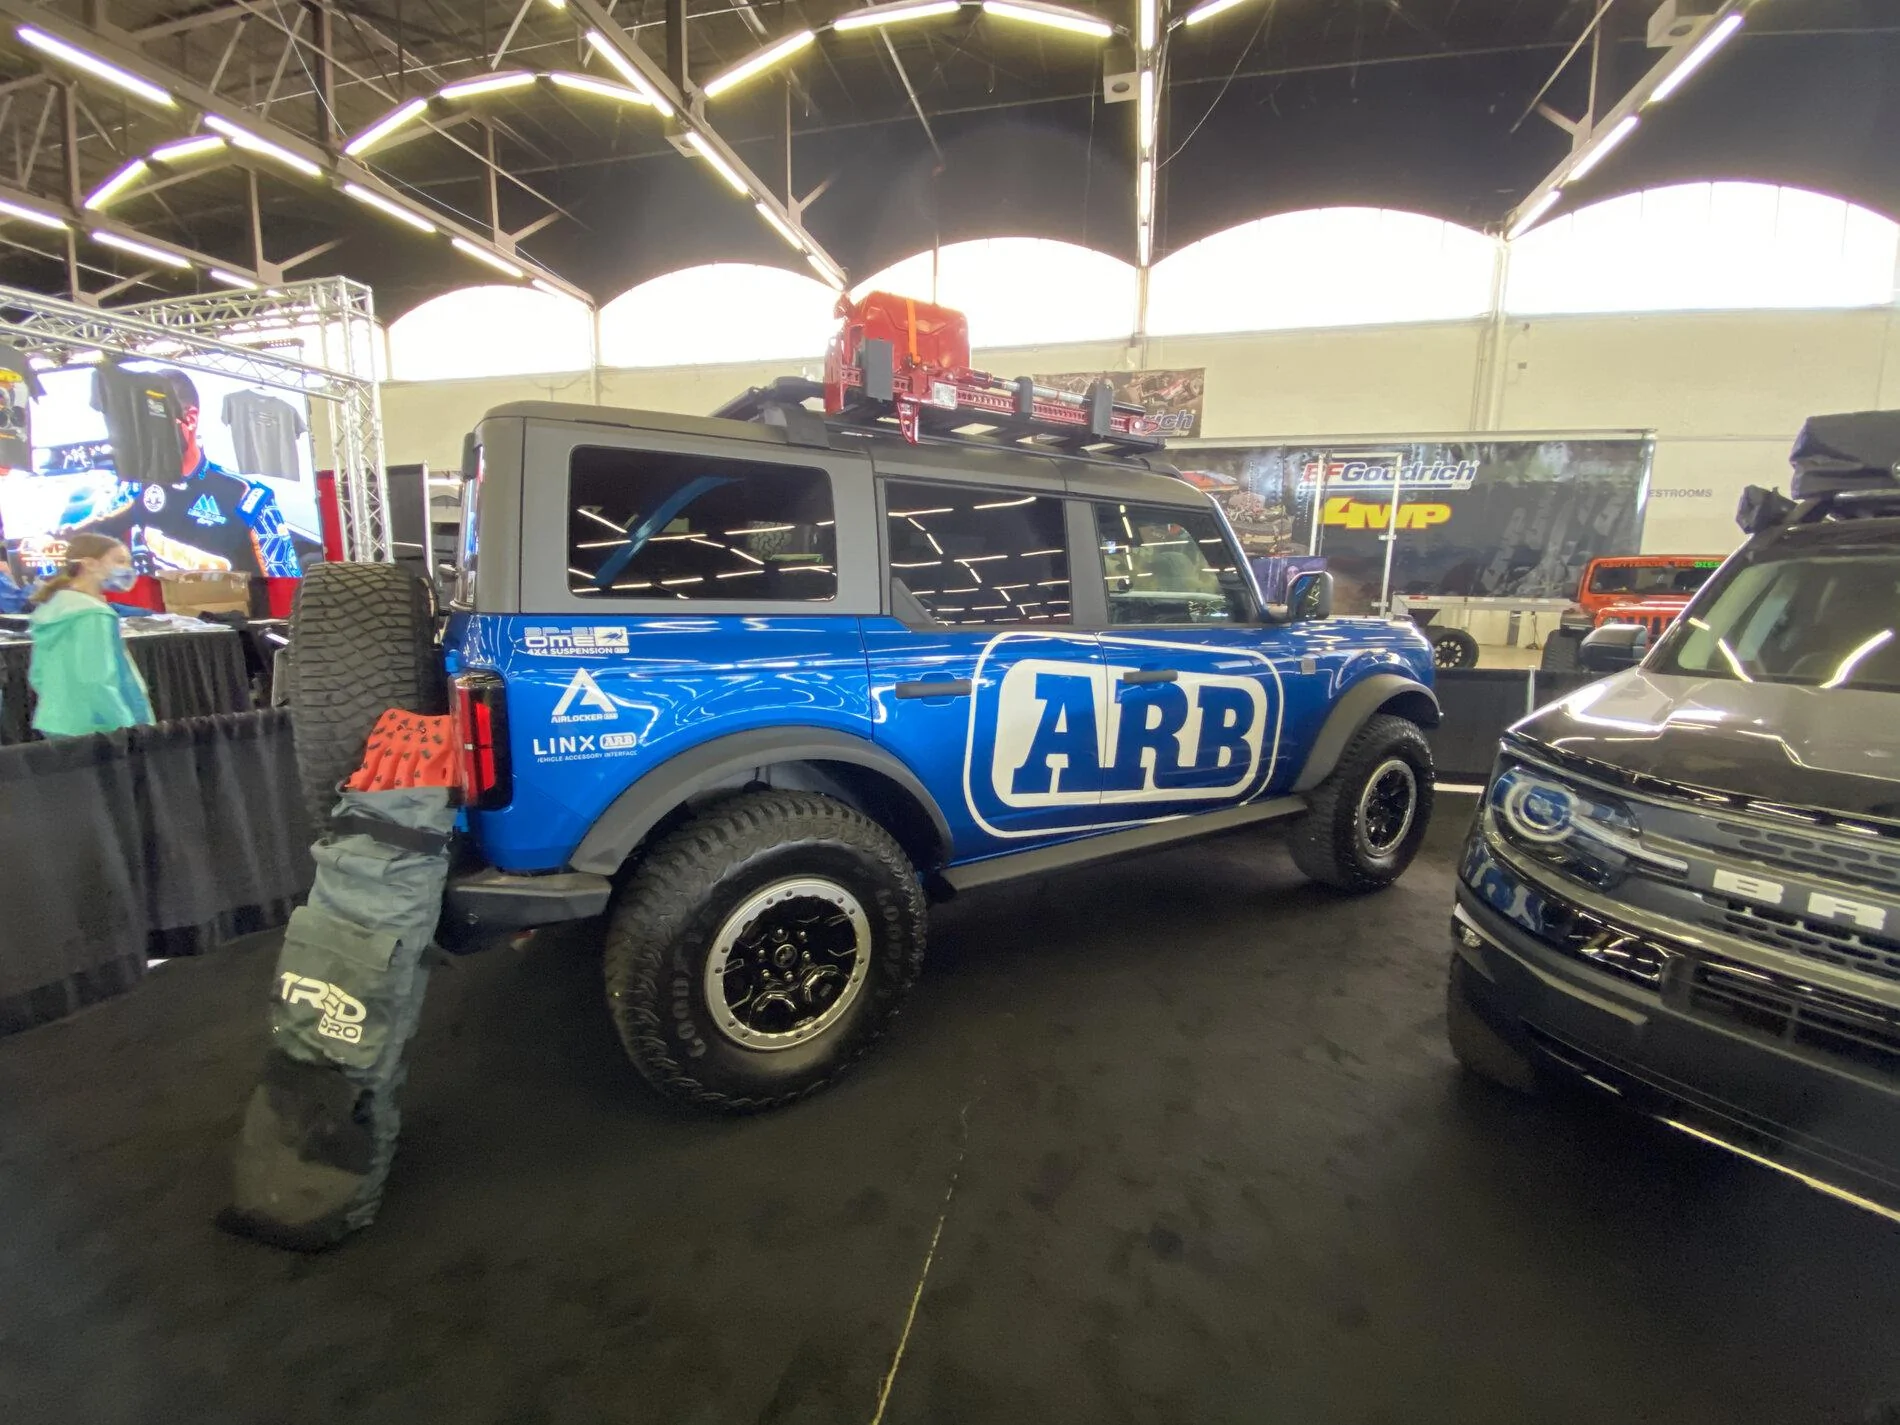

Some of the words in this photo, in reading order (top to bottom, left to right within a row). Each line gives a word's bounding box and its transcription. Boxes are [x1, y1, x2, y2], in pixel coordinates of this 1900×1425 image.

[1649, 489, 1712, 498] ESTROOMS
[551, 647, 613, 655] SUSPENSION
[1011, 672, 1254, 795] ARB
[533, 735, 595, 755] LINX
[603, 735, 634, 747] ARB
[321, 1018, 358, 1039] PRO
